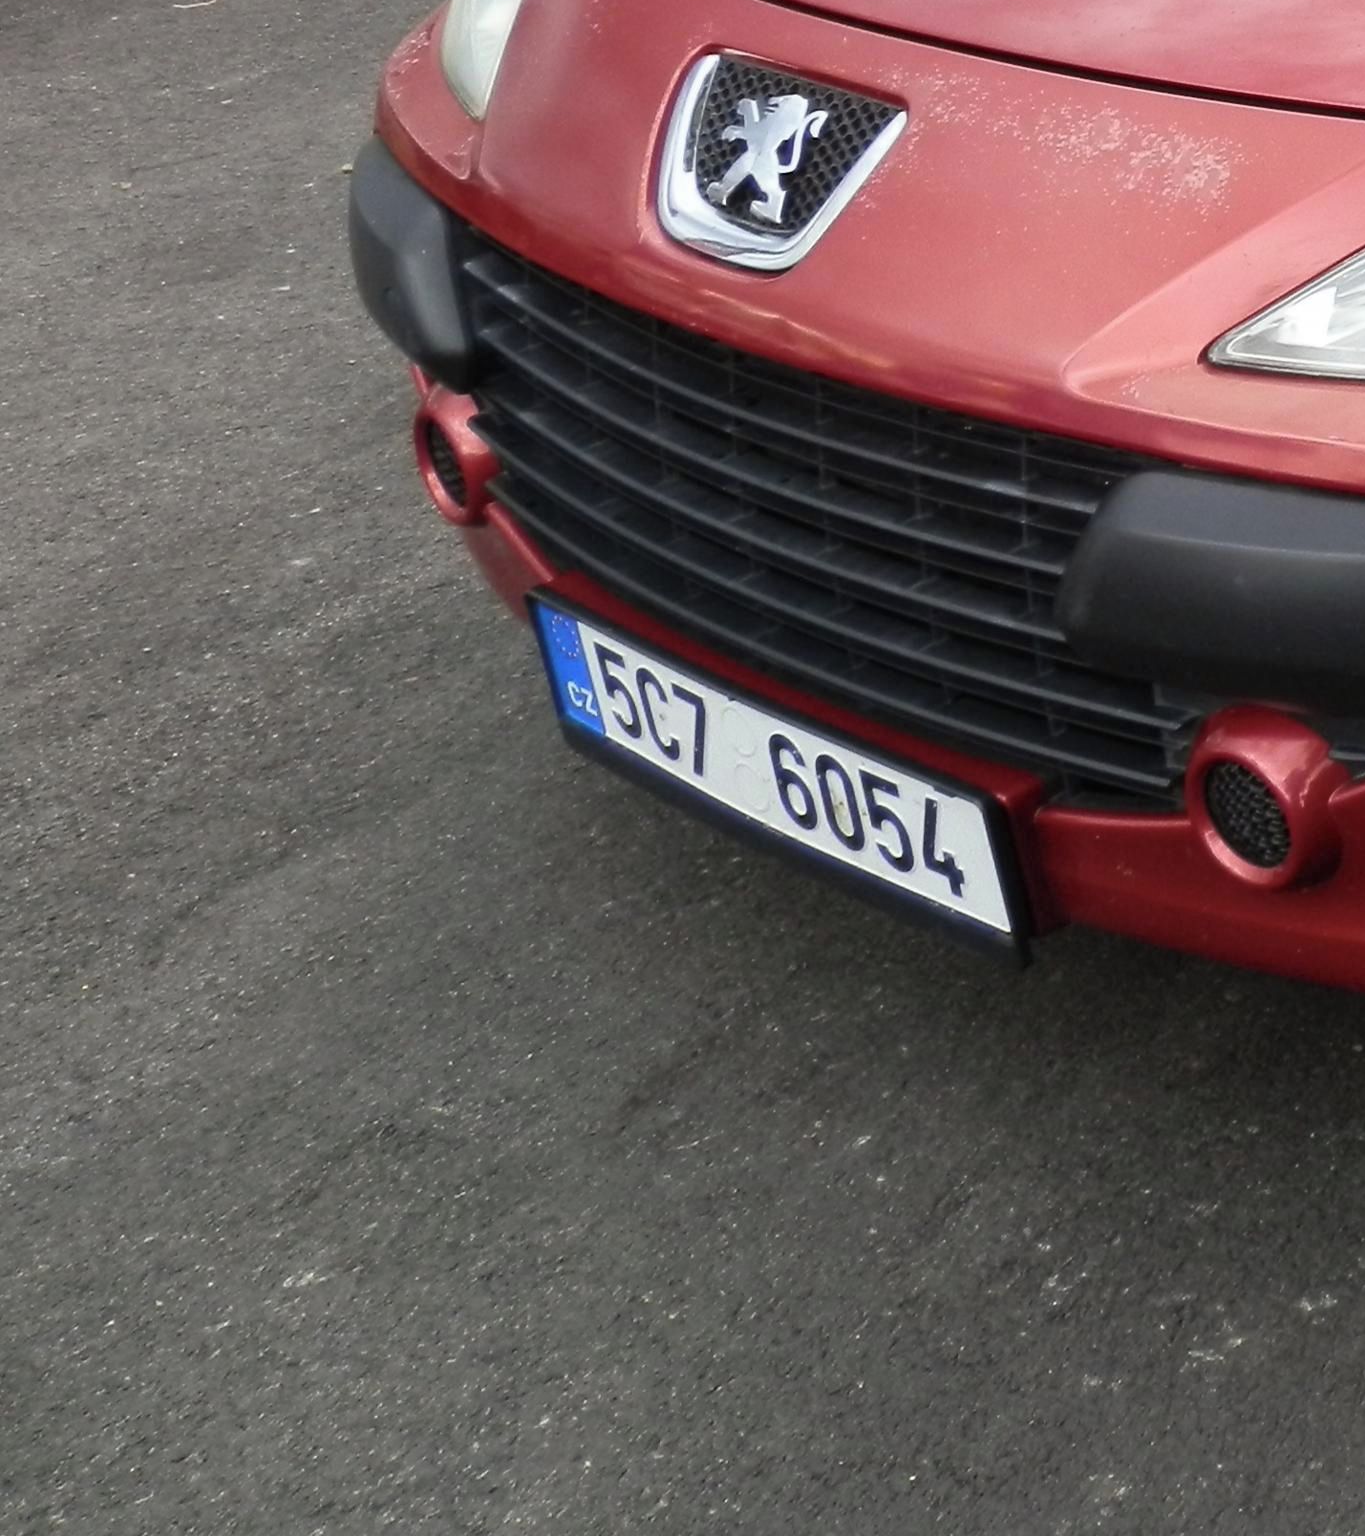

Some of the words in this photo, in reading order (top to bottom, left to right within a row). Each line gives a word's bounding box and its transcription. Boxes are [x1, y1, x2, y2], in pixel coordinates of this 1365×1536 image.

[567, 680, 598, 717] CZ
[594, 641, 706, 776] 5C7
[768, 733, 965, 898] 6054
